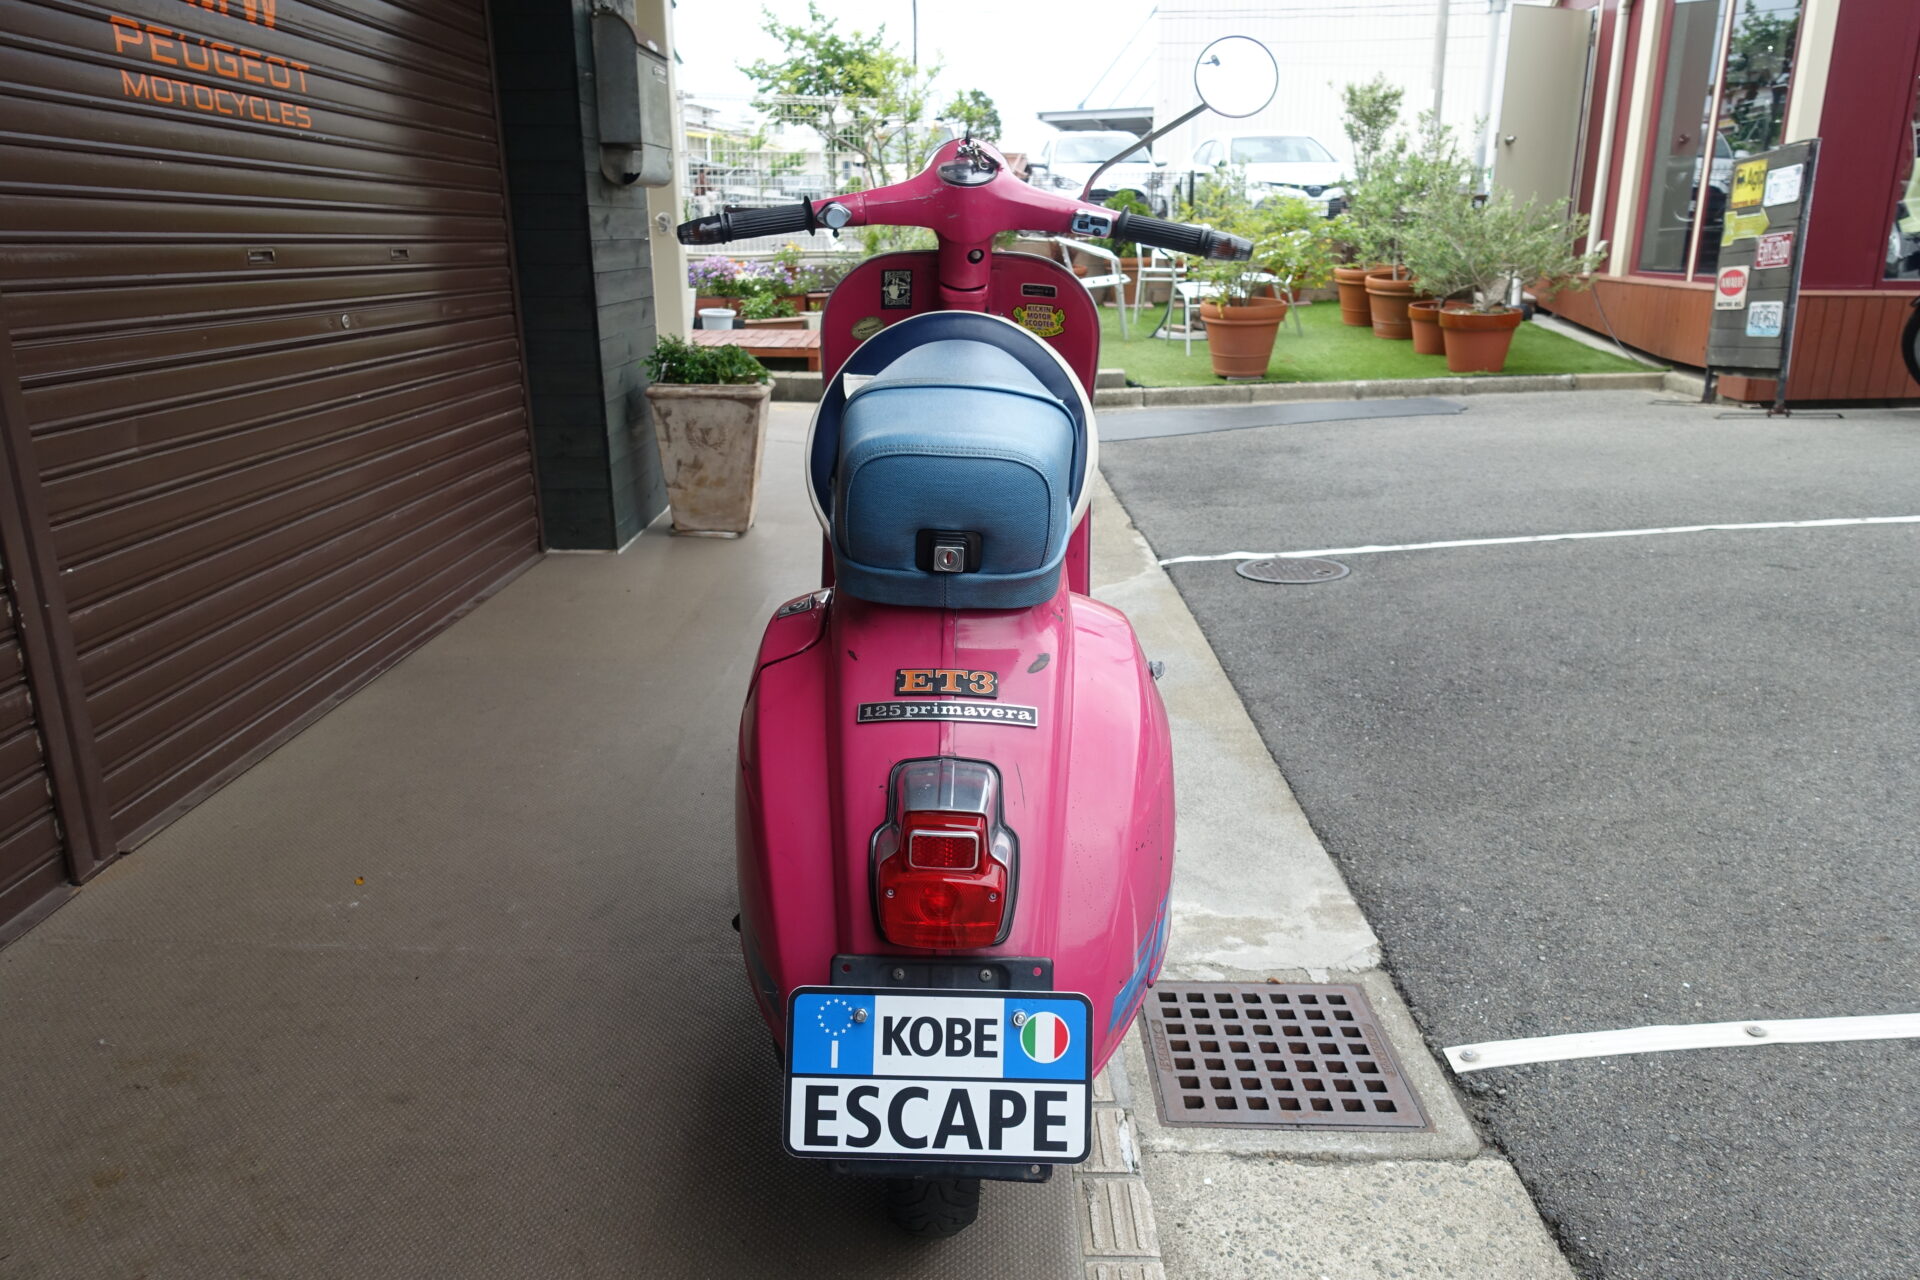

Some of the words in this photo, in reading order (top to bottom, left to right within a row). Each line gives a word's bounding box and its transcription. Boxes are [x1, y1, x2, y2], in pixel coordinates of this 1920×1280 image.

[110, 15, 310, 93] PEUGEOT
[120, 69, 312, 129] MOTOCYCLES
[1024, 319, 1055, 328] SCOOTER
[1027, 312, 1052, 320] MOTOR
[899, 669, 995, 695] ET3
[863, 704, 901, 718] 125
[904, 702, 1032, 721] primavera
[882, 1015, 999, 1058] KOBE
[803, 1084, 1069, 1153] ESCAPE
